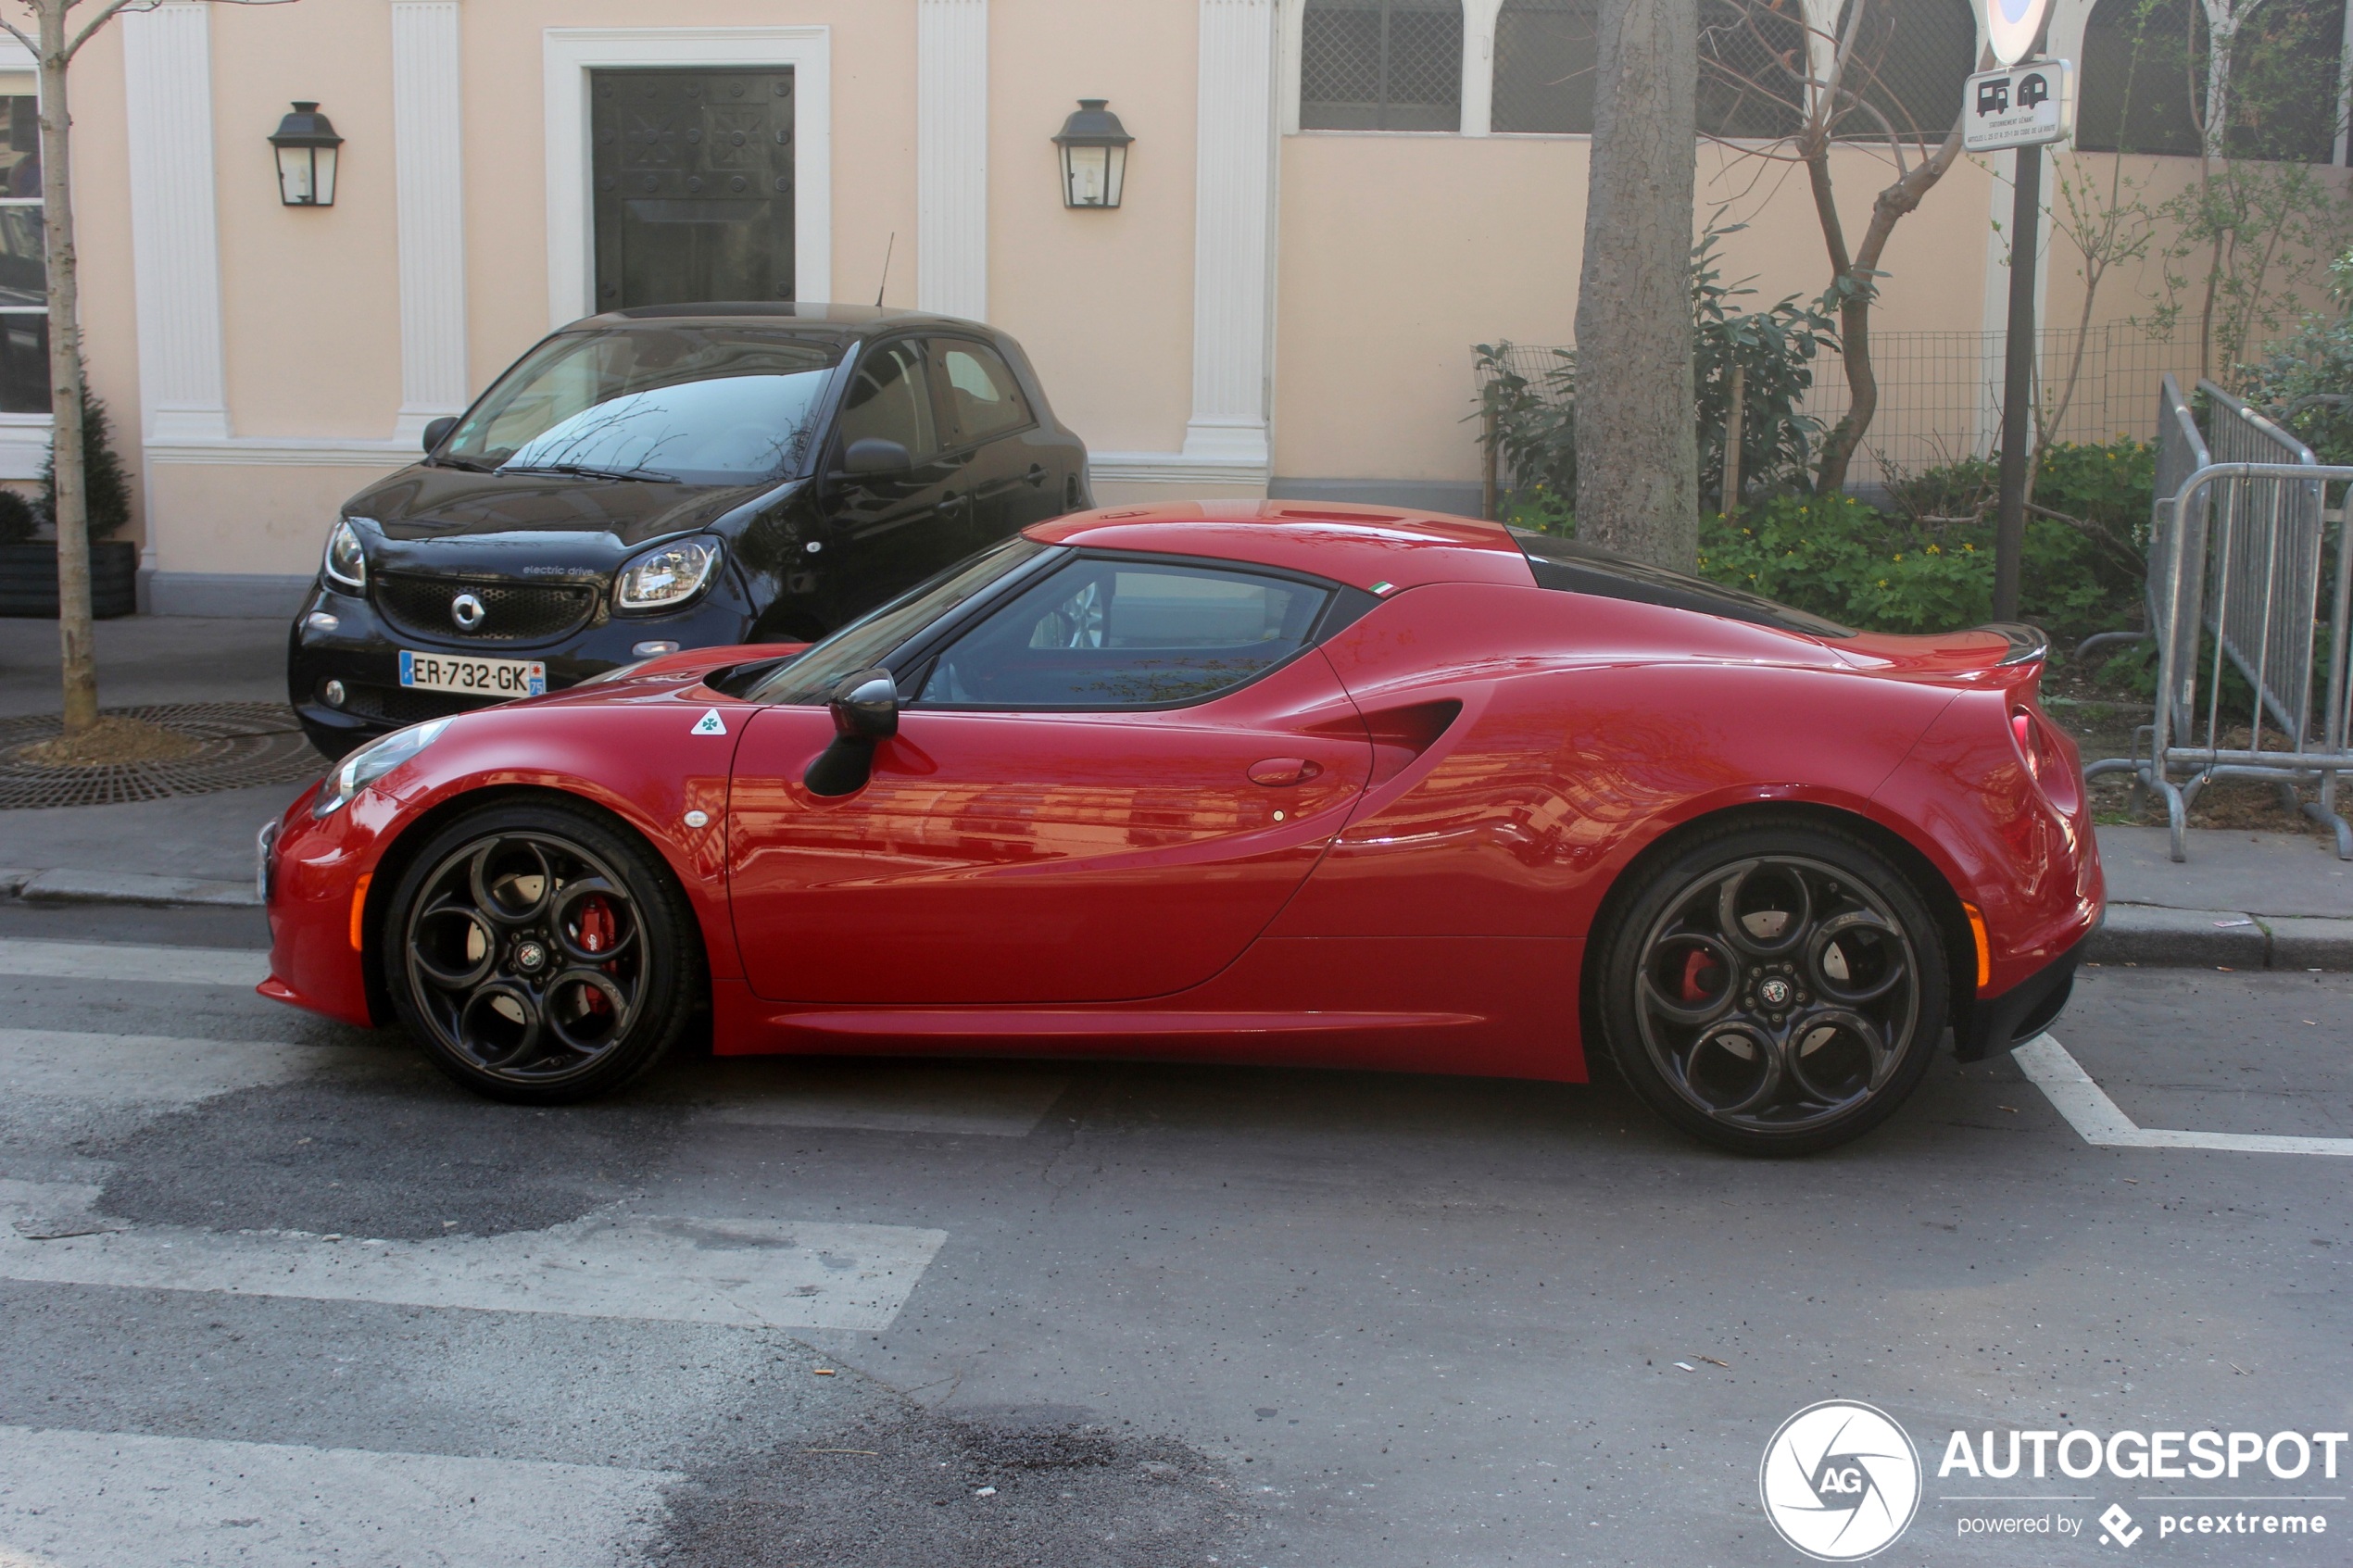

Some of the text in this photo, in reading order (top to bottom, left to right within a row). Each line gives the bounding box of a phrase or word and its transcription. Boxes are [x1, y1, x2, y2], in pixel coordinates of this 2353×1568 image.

[522, 566, 595, 576] electric drive
[414, 659, 528, 691] ER-732-GK
[531, 682, 543, 695] 75
